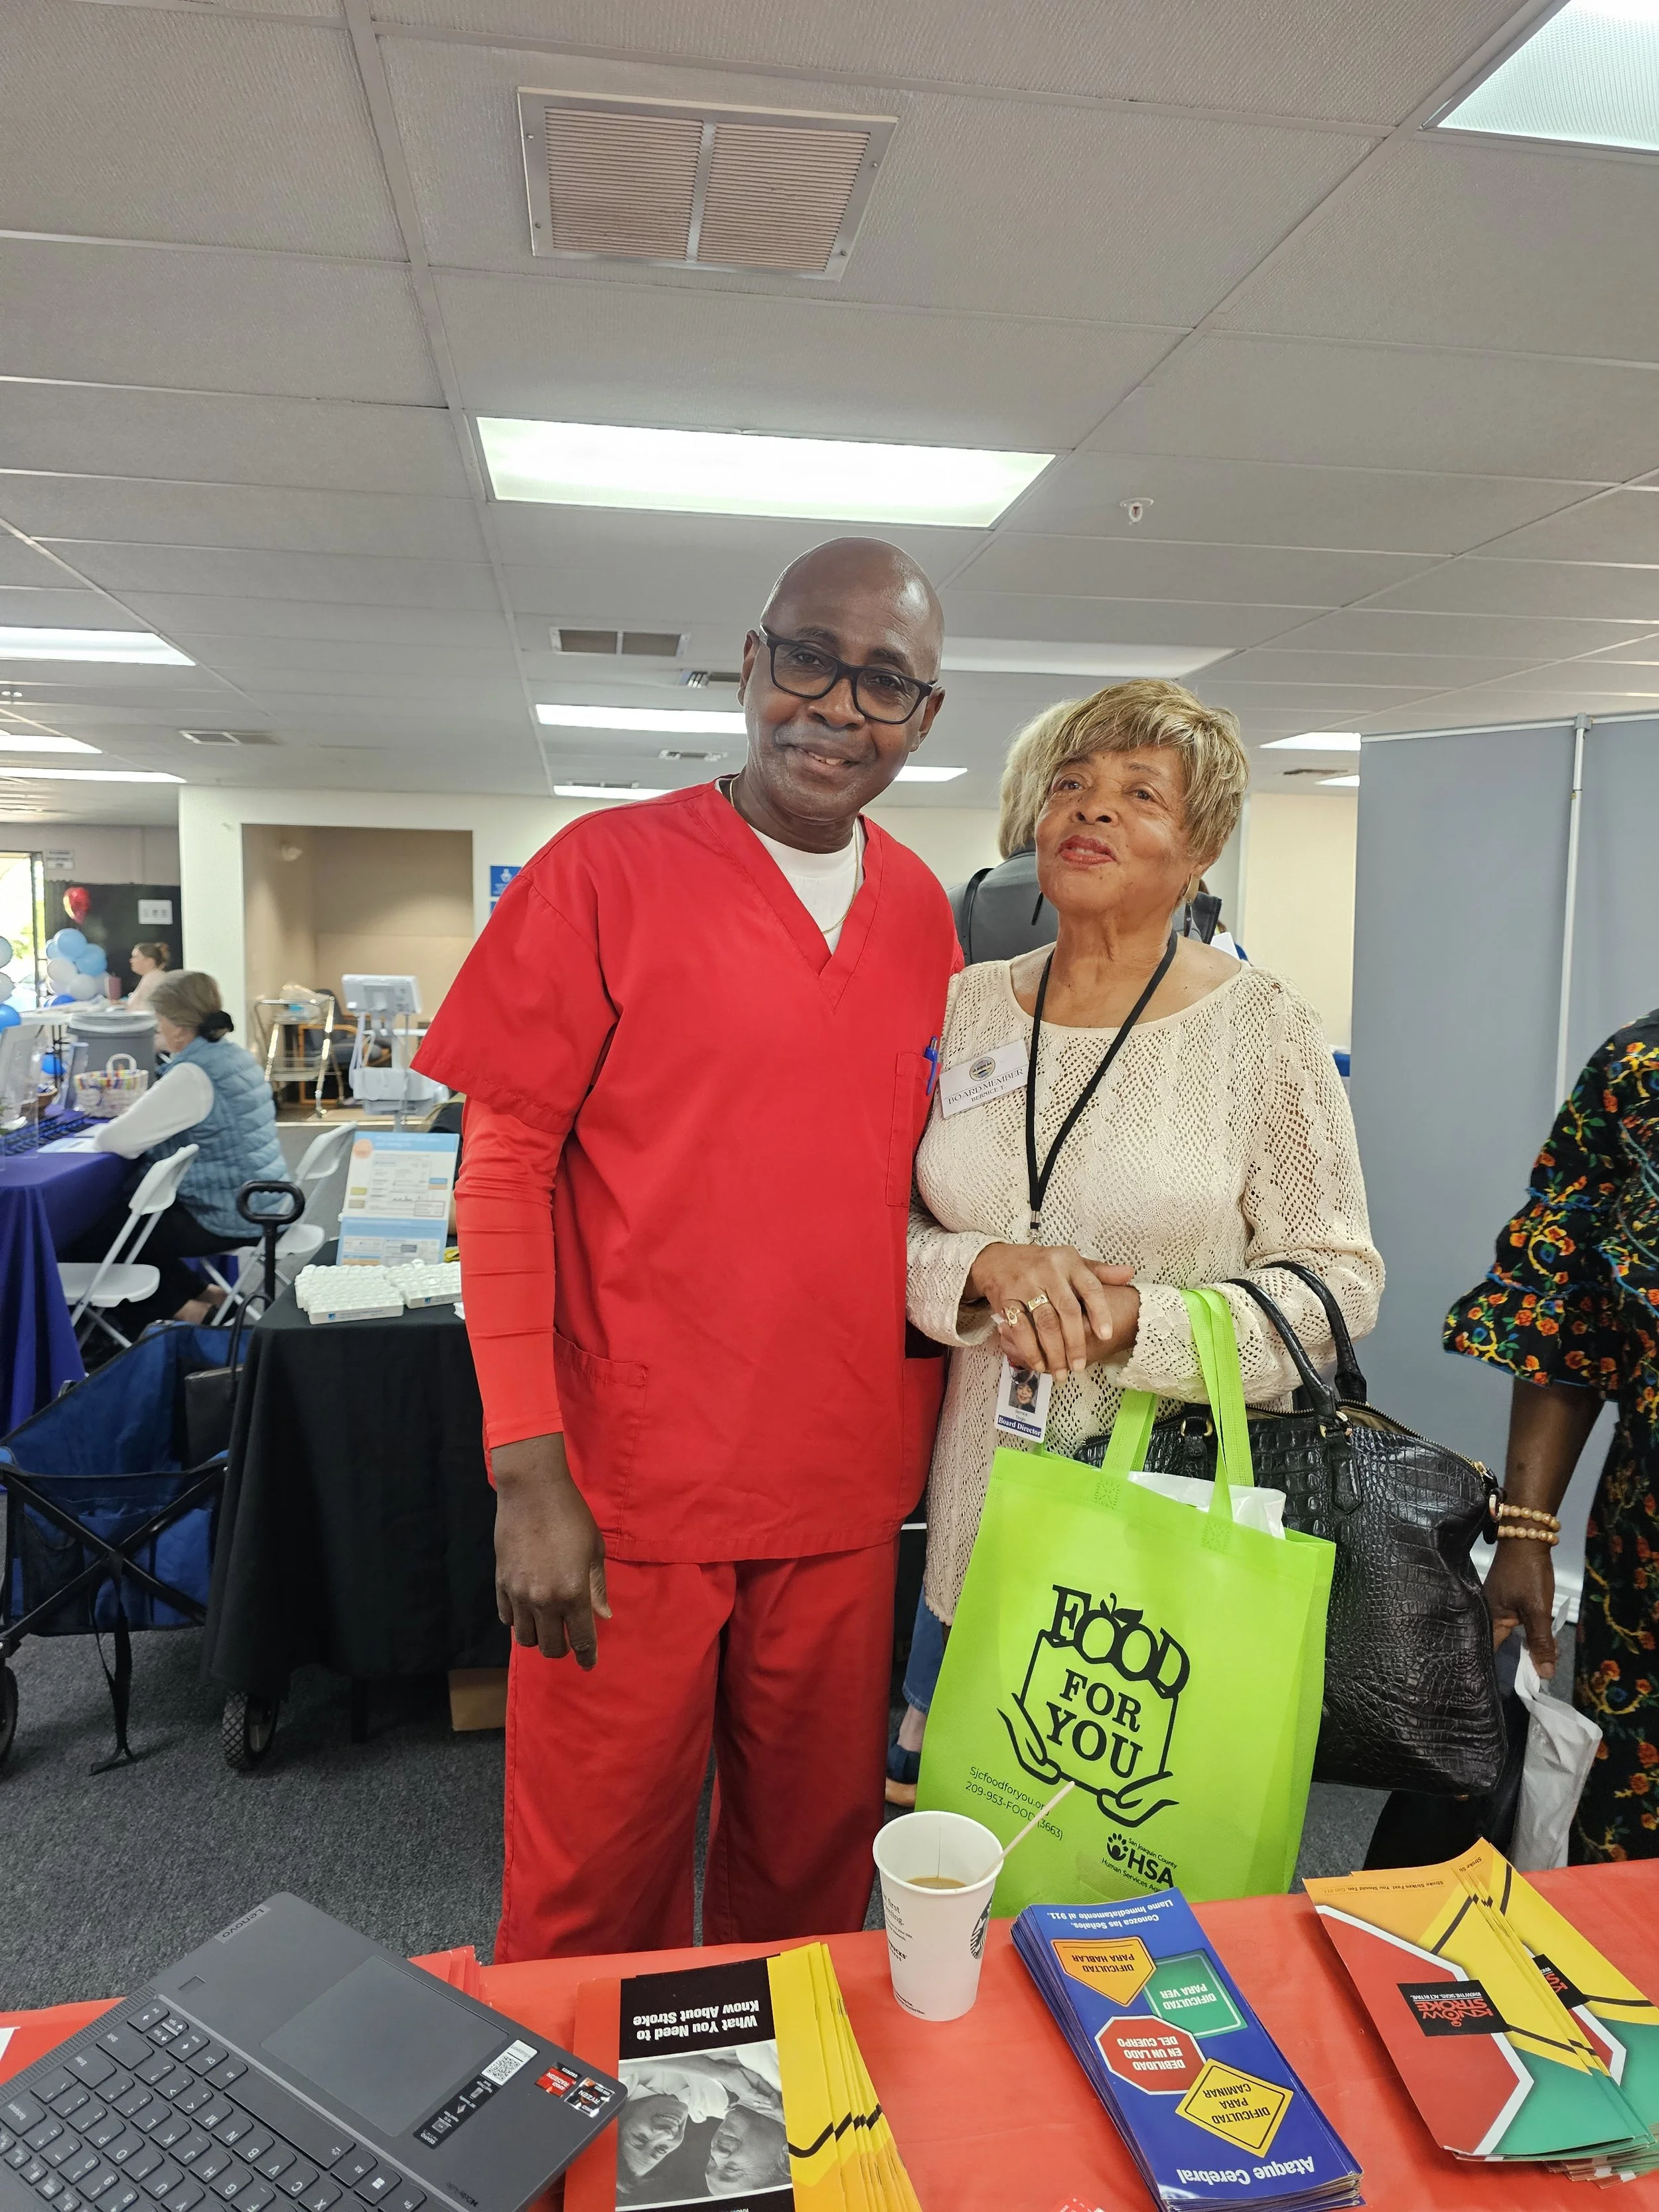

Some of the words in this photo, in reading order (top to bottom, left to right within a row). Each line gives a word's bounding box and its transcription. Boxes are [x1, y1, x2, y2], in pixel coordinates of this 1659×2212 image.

[948, 1086, 982, 1104] BOARD
[983, 1069, 1023, 1088] MEMBER
[971, 1088, 998, 1102] BERNICE
[998, 1416, 1016, 1428] Board
[1017, 1422, 1041, 1436] Director
[1052, 1584, 1190, 1698] FOOD
[1059, 1668, 1141, 1732] FOR
[1046, 1701, 1143, 1779] YOU
[970, 1766, 1050, 1816] Sjcfoodforyou.or
[1037, 1818, 1063, 1841] (3663)
[1128, 1838, 1137, 1847] San
[1137, 1844, 1157, 1858] Joaquin
[1157, 1854, 1177, 1869] County
[1127, 1848, 1174, 1888] HSA
[1468, 1856, 1482, 1868] Stroke
[1101, 1858, 1121, 1874] Human
[1123, 1870, 1147, 1887] Services
[1147, 1899, 1174, 1911] Llame
[1078, 1907, 1147, 1920] Inmediatamente
[1123, 1914, 1159, 1925] Conozca
[222, 1909, 264, 1937] Lenovo
[1109, 1953, 1135, 1962] PARA
[1082, 1964, 1135, 1973] DIFICULTAD
[1159, 1990, 1181, 1999] VER
[1180, 1983, 1208, 1996] PARA
[722, 2000, 760, 2014] Know
[1163, 1993, 1217, 2010] DIFICULTAD
[1415, 1998, 1487, 2012] STROKE
[633, 2012, 678, 2027] Stroke
[680, 2006, 719, 2022] About
[1423, 2008, 1494, 2020] KNOW
[692, 2021, 719, 2033] You
[721, 2015, 758, 2031] What
[107, 2033, 119, 2043] Shift
[636, 2029, 651, 2041] to
[654, 2025, 689, 2040] Need
[1116, 2037, 1158, 2047] CUERPO
[1157, 2035, 1179, 2046] DEL
[1123, 2049, 1152, 2059] LADO
[1151, 2048, 1167, 2057] UN
[1167, 2047, 1183, 2057] EN
[75, 2055, 88, 2067] Enter
[205, 2056, 216, 2065] Ctrl
[1132, 2059, 1187, 2071] DEBILIDAD
[546, 2072, 571, 2088] RADEON
[552, 2082, 565, 2091] AMD
[1202, 2083, 1252, 2099] CAMINAR
[578, 2090, 601, 2104] RYZEN
[1219, 2097, 1249, 2109] PARA
[205, 2114, 218, 2125] M
[1211, 2106, 1271, 2124] DIFICULTAD
[147, 2118, 157, 2128] L
[98, 2135, 110, 2144] P
[163, 2134, 176, 2144] K
[226, 2130, 238, 2142] N
[184, 2150, 196, 2159] J
[248, 2148, 259, 2158] B
[203, 2166, 216, 2178] H
[268, 2165, 280, 2175] V
[354, 2165, 364, 2174] Alt
[1252, 2156, 1315, 2179] Ataque
[1176, 2169, 1251, 2185] Cerebral
[155, 2183, 168, 2195] U
[224, 2183, 237, 2195] G
[291, 2181, 303, 2192] C
[123, 2193, 133, 2203] 8
[176, 2201, 187, 2212] Y
[314, 2198, 327, 2211] X
[403, 2200, 413, 2209] Fn
